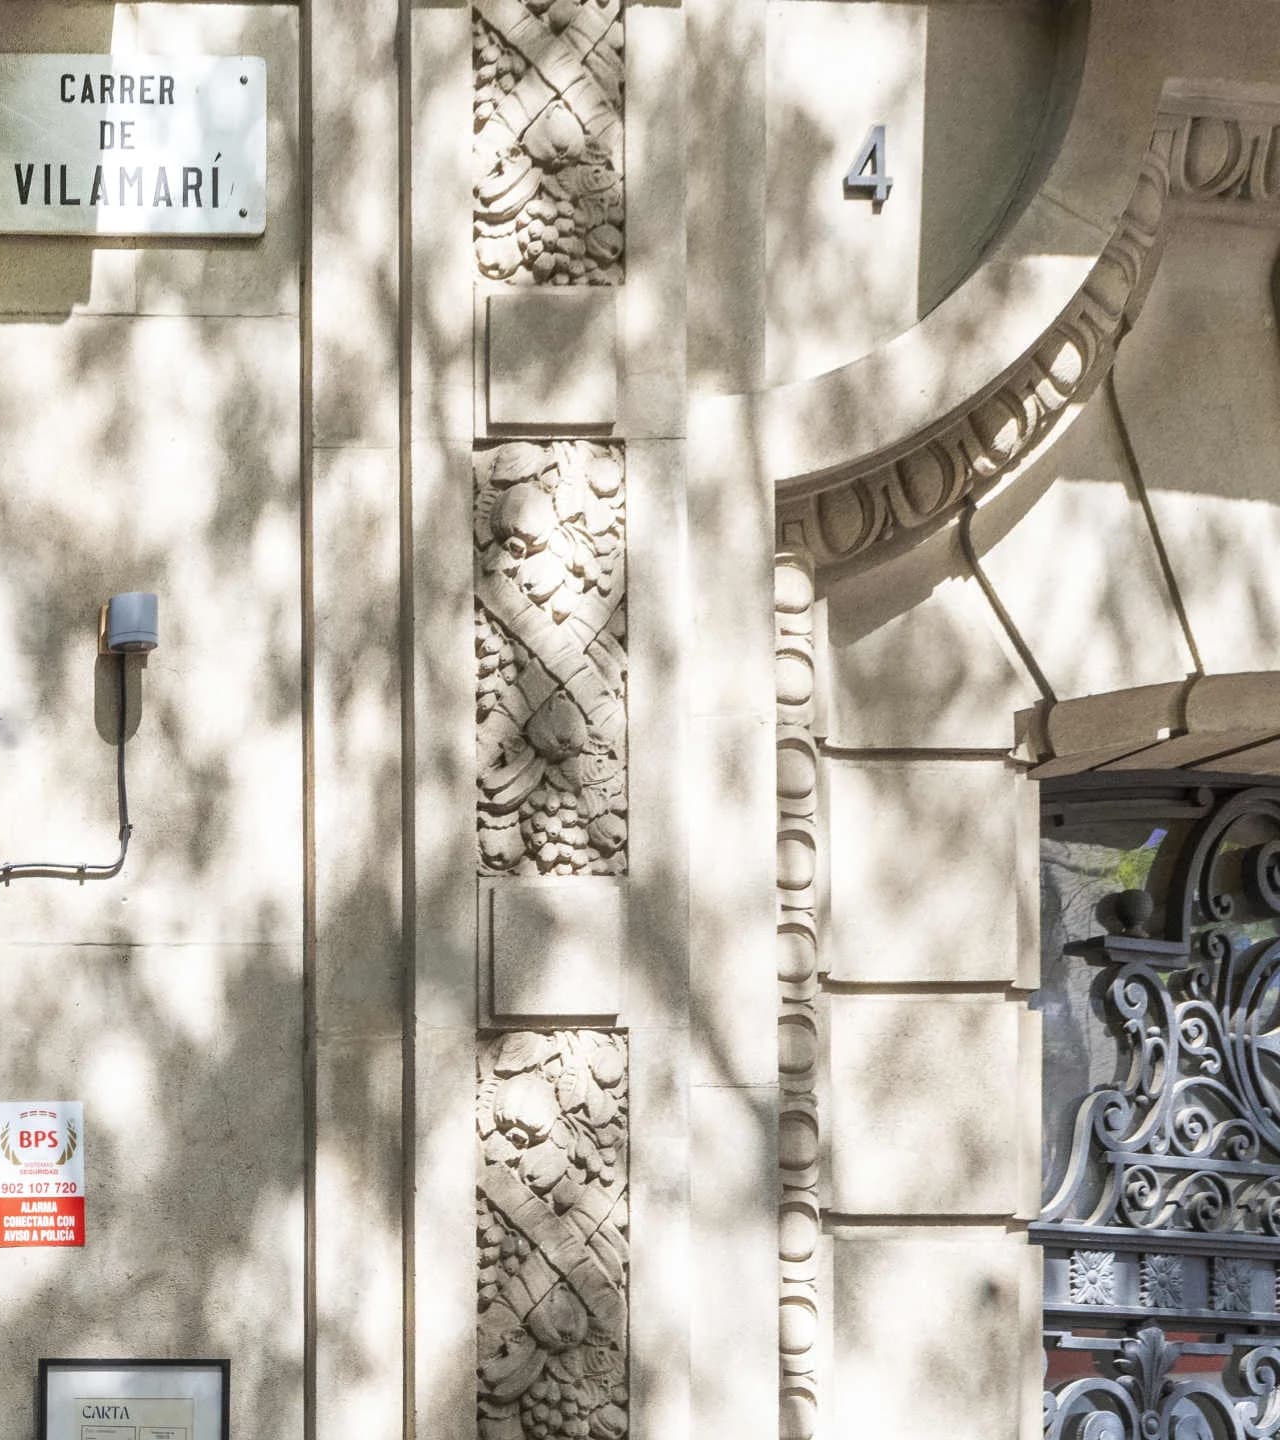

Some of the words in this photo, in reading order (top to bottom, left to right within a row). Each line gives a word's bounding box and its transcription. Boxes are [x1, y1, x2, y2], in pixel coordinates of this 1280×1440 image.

[60, 73, 175, 105] CARRER
[99, 120, 135, 150] DE
[844, 125, 893, 201] 4
[14, 152, 222, 208] VILAMARÍ
[19, 1130, 59, 1149] BPS
[1, 1183, 24, 1194] 902
[29, 1183, 50, 1194] 107
[55, 1182, 77, 1194] 720
[21, 1201, 58, 1213] ALARMA
[56, 1216, 75, 1227] CON
[3, 1230, 30, 1241] AVISO
[31, 1230, 39, 1241] A
[40, 1227, 75, 1241] POLICÍA
[82, 1405, 130, 1420] CARTA
